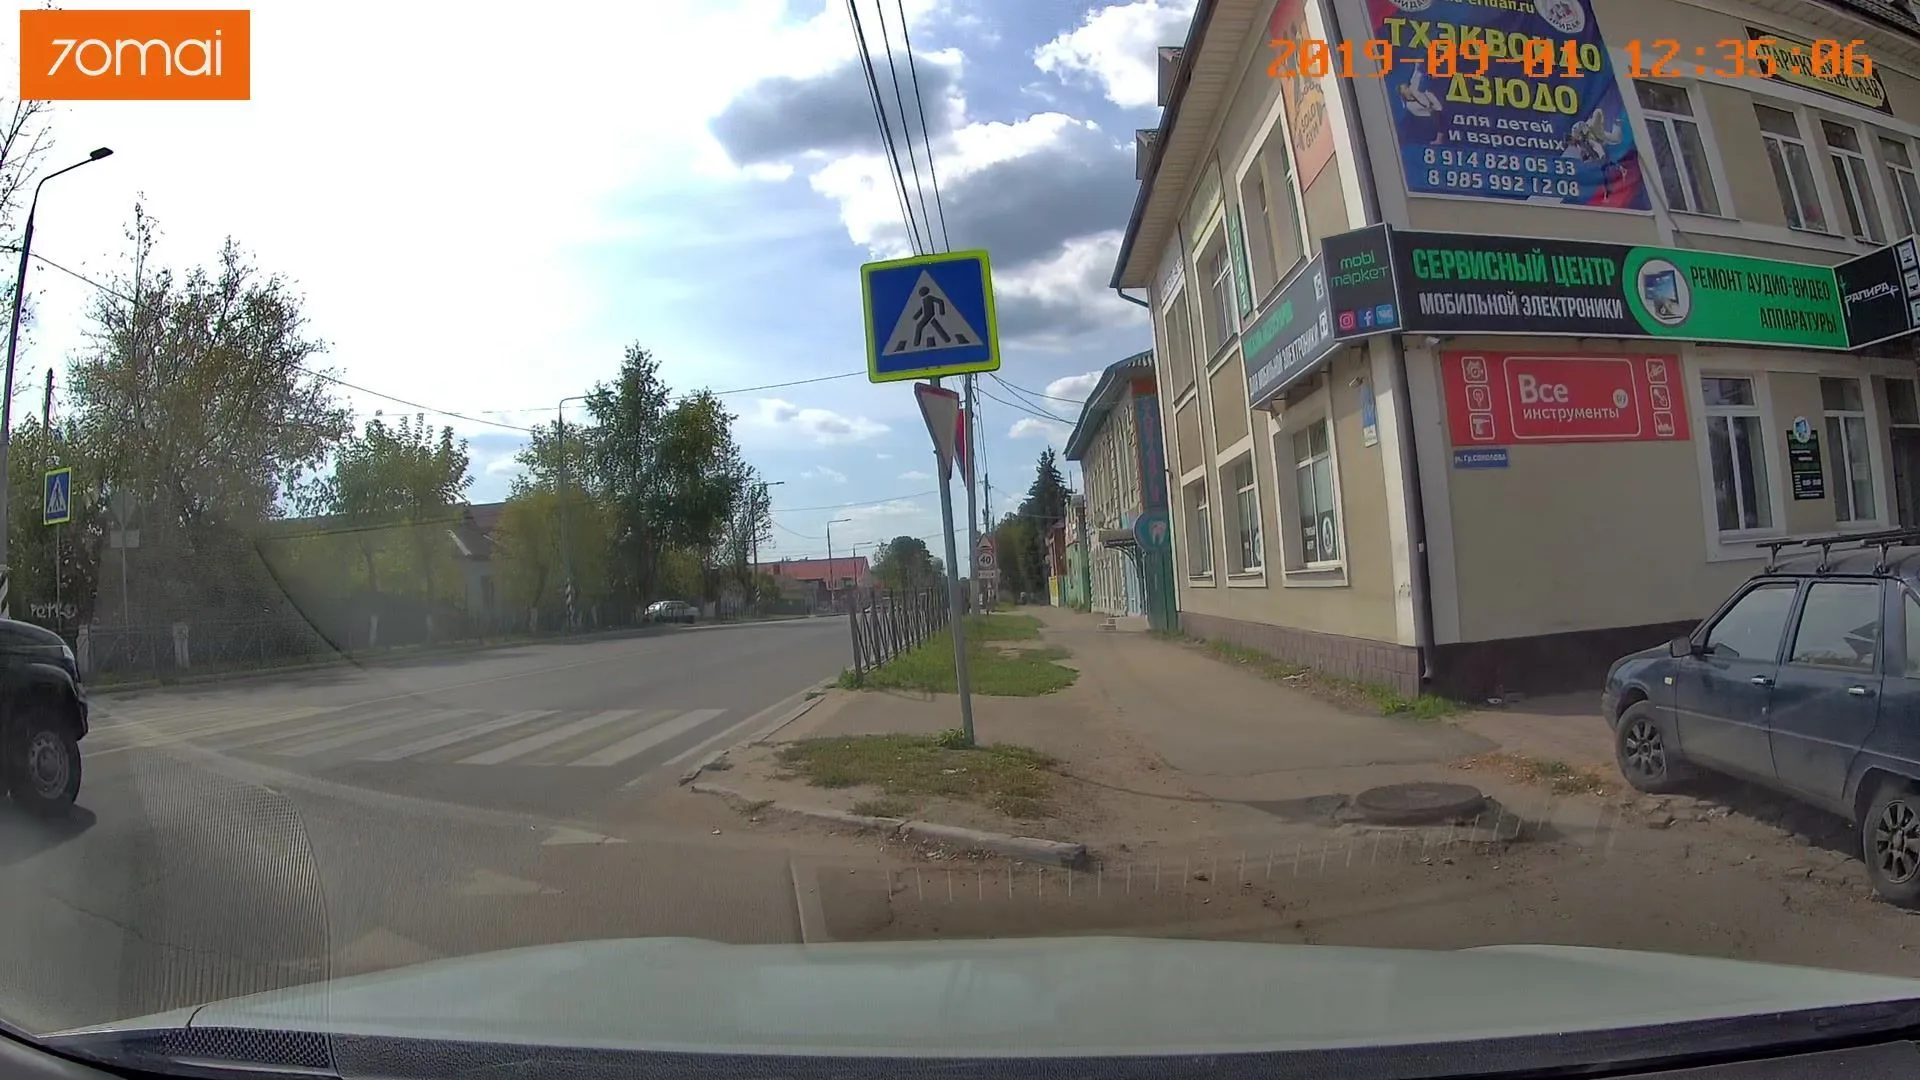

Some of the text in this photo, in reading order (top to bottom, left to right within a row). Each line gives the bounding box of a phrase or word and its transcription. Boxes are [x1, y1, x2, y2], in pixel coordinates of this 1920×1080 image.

[1760, 43, 1883, 101] ПАРИКЕРСКАЯ
[1445, 72, 1579, 115] ДЗЮДО
[1452, 114, 1553, 134] для детей
[1449, 129, 1565, 151] и взрослых
[1423, 148, 1576, 176] 8 914 828 05 33
[1427, 169, 1580, 197] 8 985 992 12 08
[1412, 247, 1616, 288] СЕРВИСНЫЙ ЦЕНТР
[1690, 265, 1831, 302] РЕМОНТ АУДИО-ВИДЕО
[1844, 281, 1890, 313] РАПИРА
[1418, 290, 1624, 320] МОБИЛЬНОЙ ЭЛЕКТРОНИКИ
[1760, 307, 1838, 333] АППАРАТУРЫ
[1517, 373, 1569, 404] Все
[1522, 407, 1620, 423] инструменты
[980, 555, 991, 564] 40
